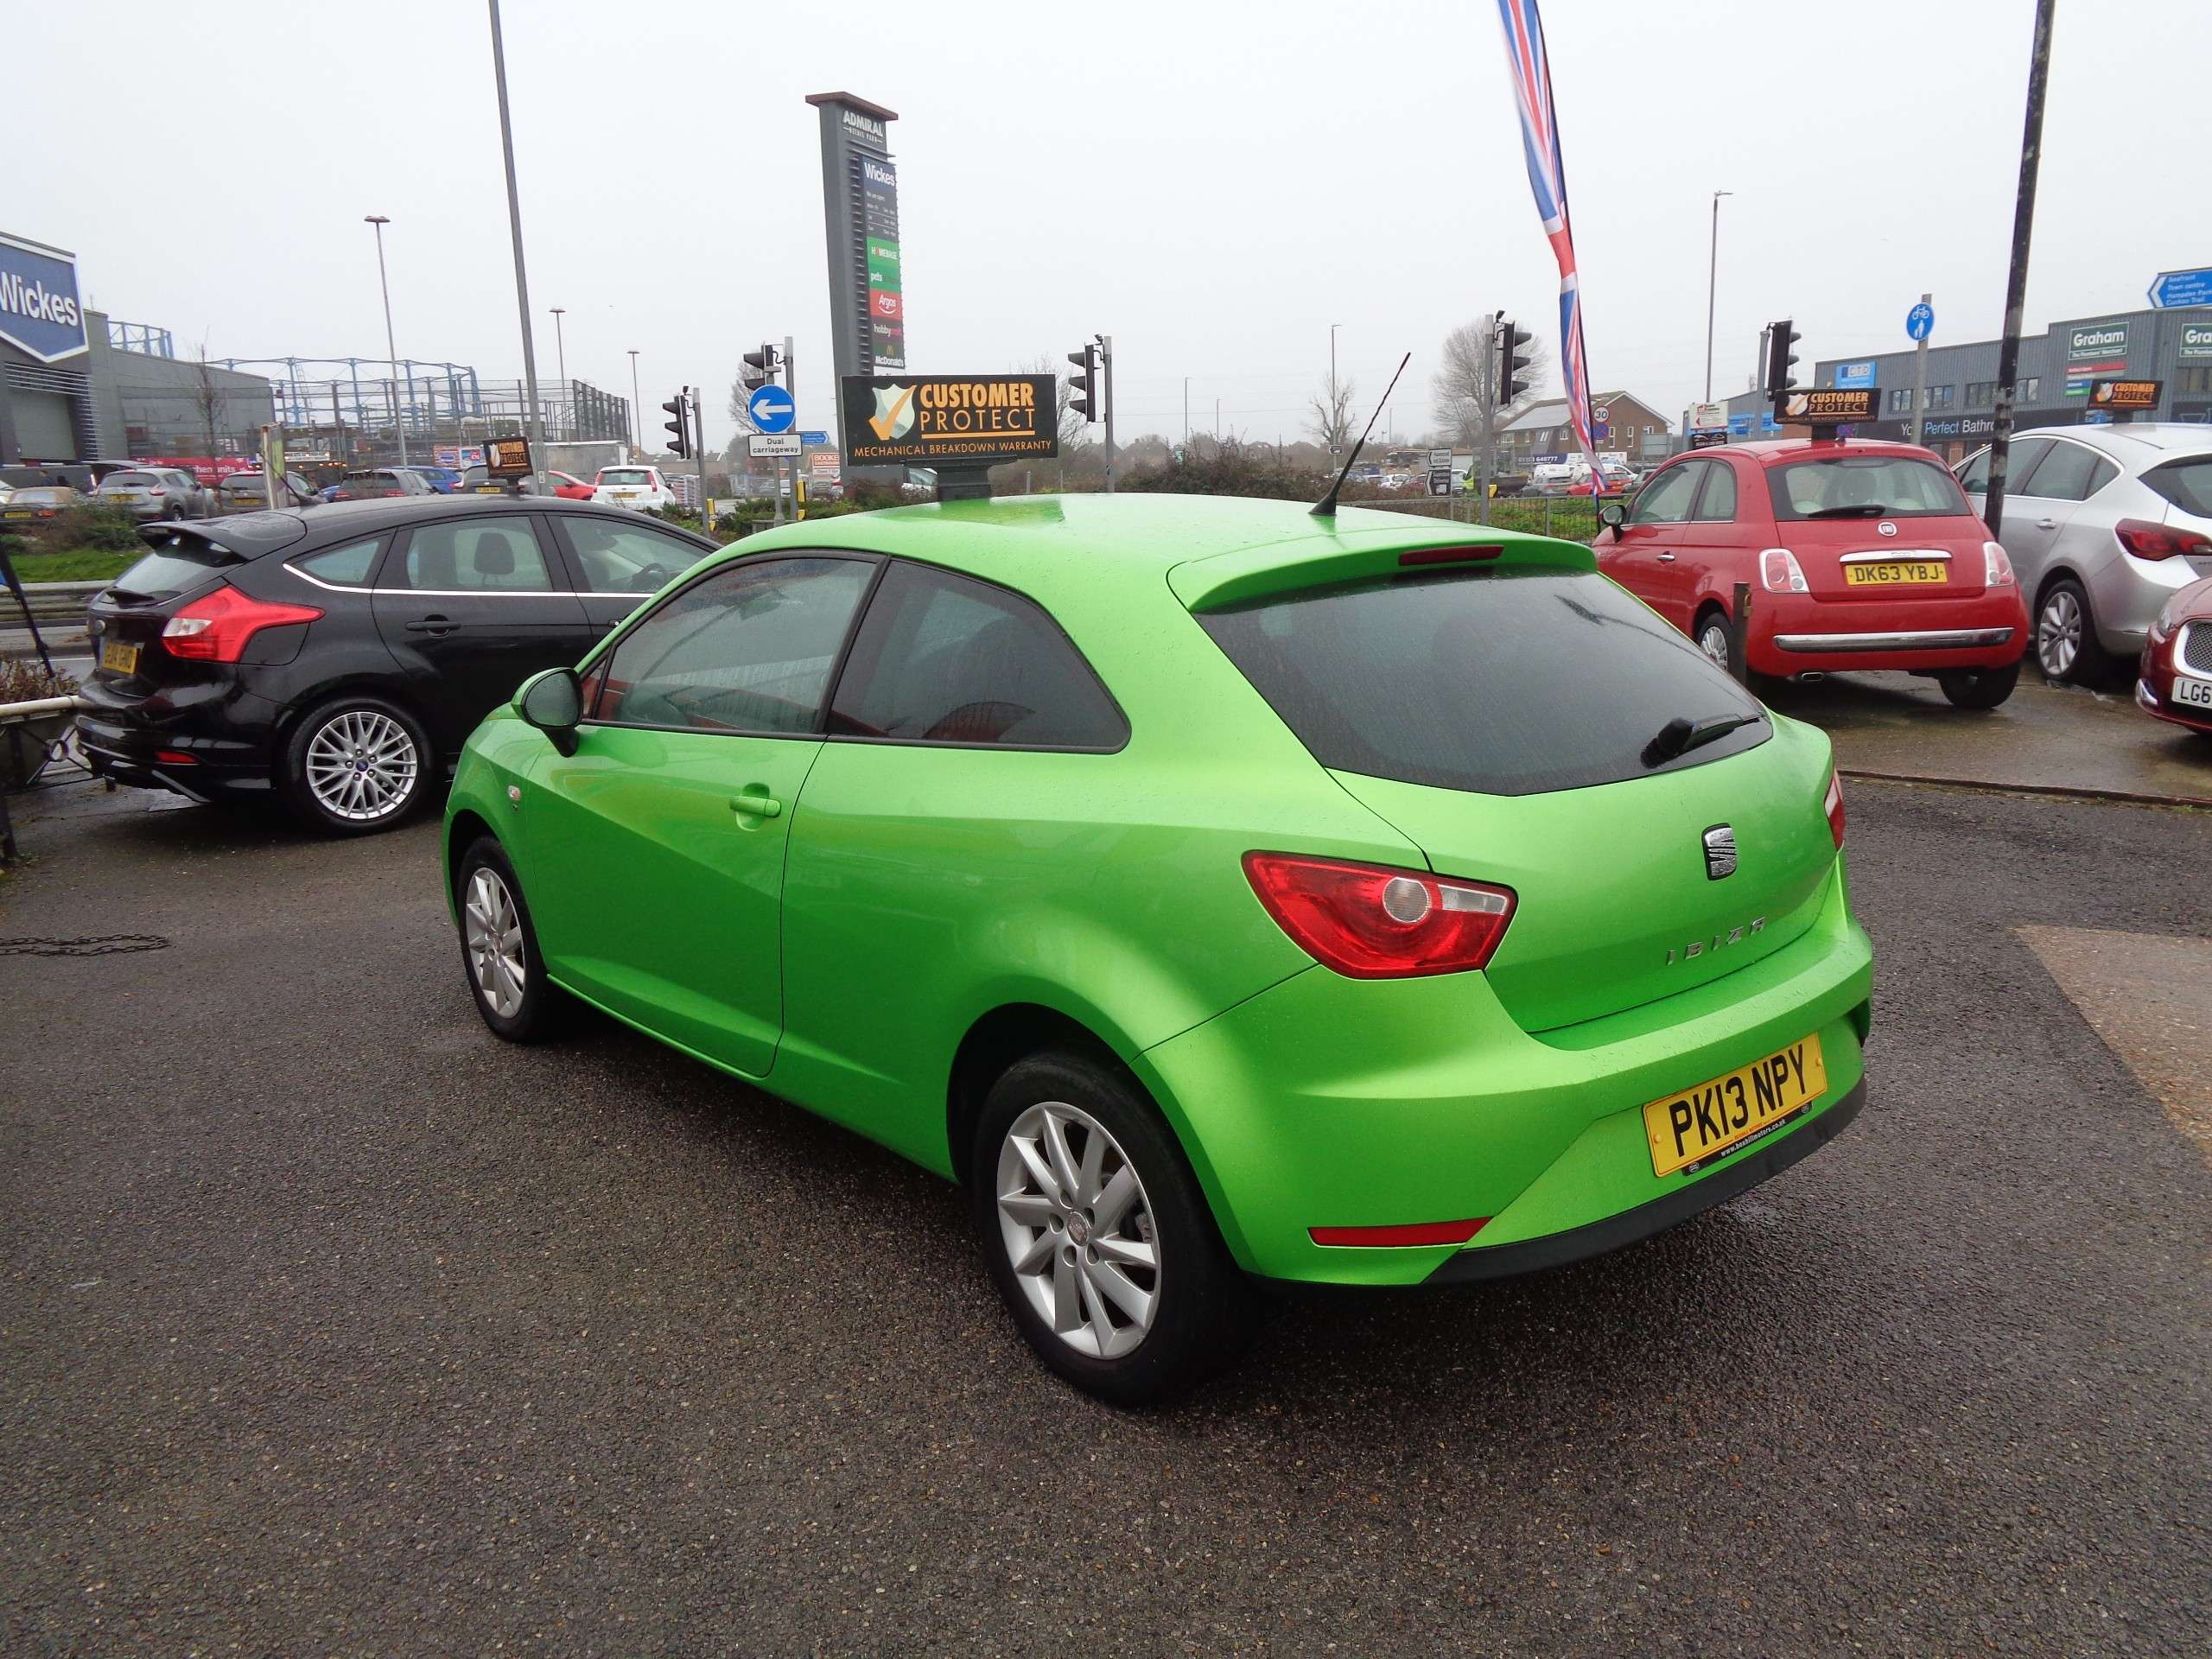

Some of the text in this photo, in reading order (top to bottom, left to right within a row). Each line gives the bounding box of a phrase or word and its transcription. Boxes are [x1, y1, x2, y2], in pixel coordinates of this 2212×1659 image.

[842, 111, 883, 137] ADMIRAL
[864, 162, 895, 186] Wickes
[0, 271, 79, 327] Wickes
[879, 294, 897, 308] Argos
[2074, 331, 2125, 346] Graham
[920, 383, 1034, 408] CUSTOMER
[1810, 392, 1869, 403] CUSTOMER
[1595, 410, 1608, 419] 30
[1808, 403, 1868, 412] PROTECT
[920, 408, 1035, 431] PROTECT
[1924, 421, 1960, 435] Perfect
[855, 441, 1052, 457] MECHANICAL BREAKDOWN WARRANTY
[1854, 564, 1939, 582] DK63 YBJ
[2180, 682, 2212, 703] LG6
[1669, 1044, 1806, 1158] PK13 NPY
